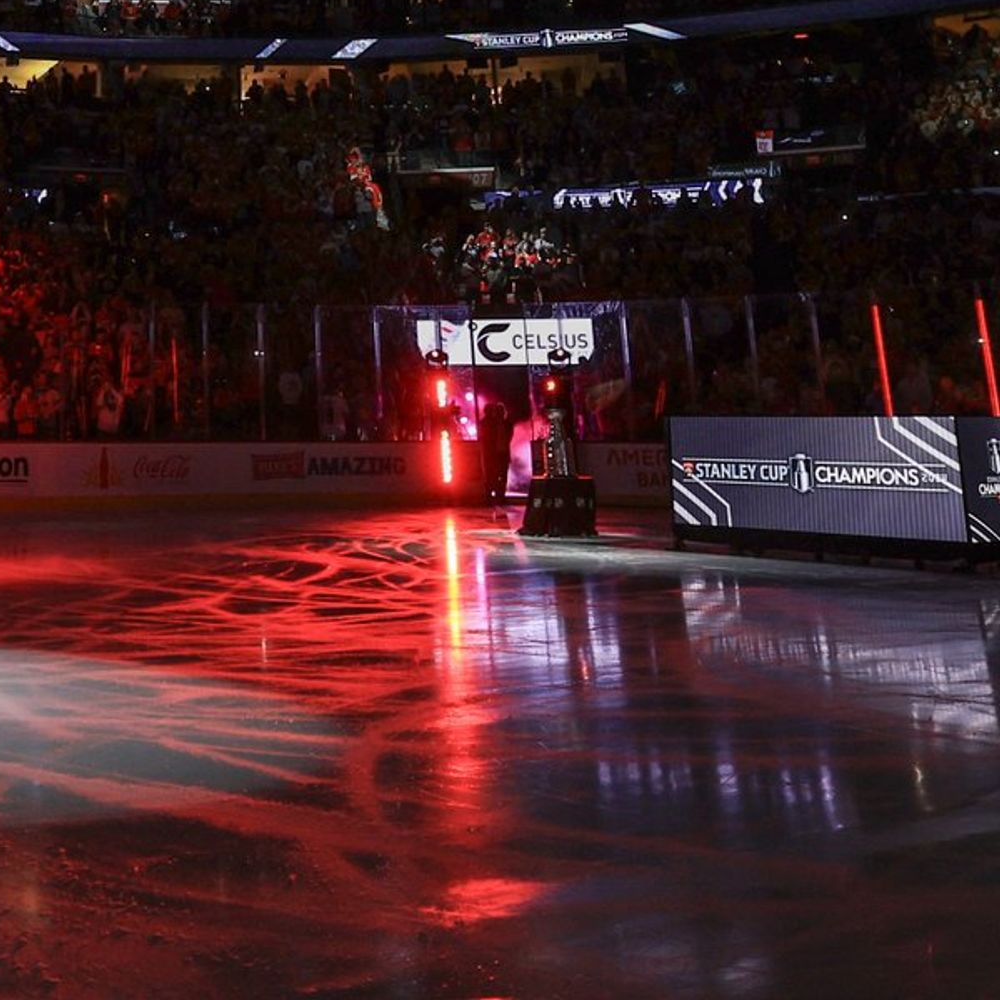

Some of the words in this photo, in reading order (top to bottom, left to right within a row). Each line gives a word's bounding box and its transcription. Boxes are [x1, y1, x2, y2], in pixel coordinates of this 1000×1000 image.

[483, 36, 522, 47] STANLEY
[523, 36, 541, 45] CUP
[555, 31, 613, 44] CHAMPIONS
[307, 456, 407, 476] AMAZING
[695, 463, 756, 480] STANLEY
[760, 465, 787, 481] CUP
[814, 466, 920, 487] CHAMPIONS
